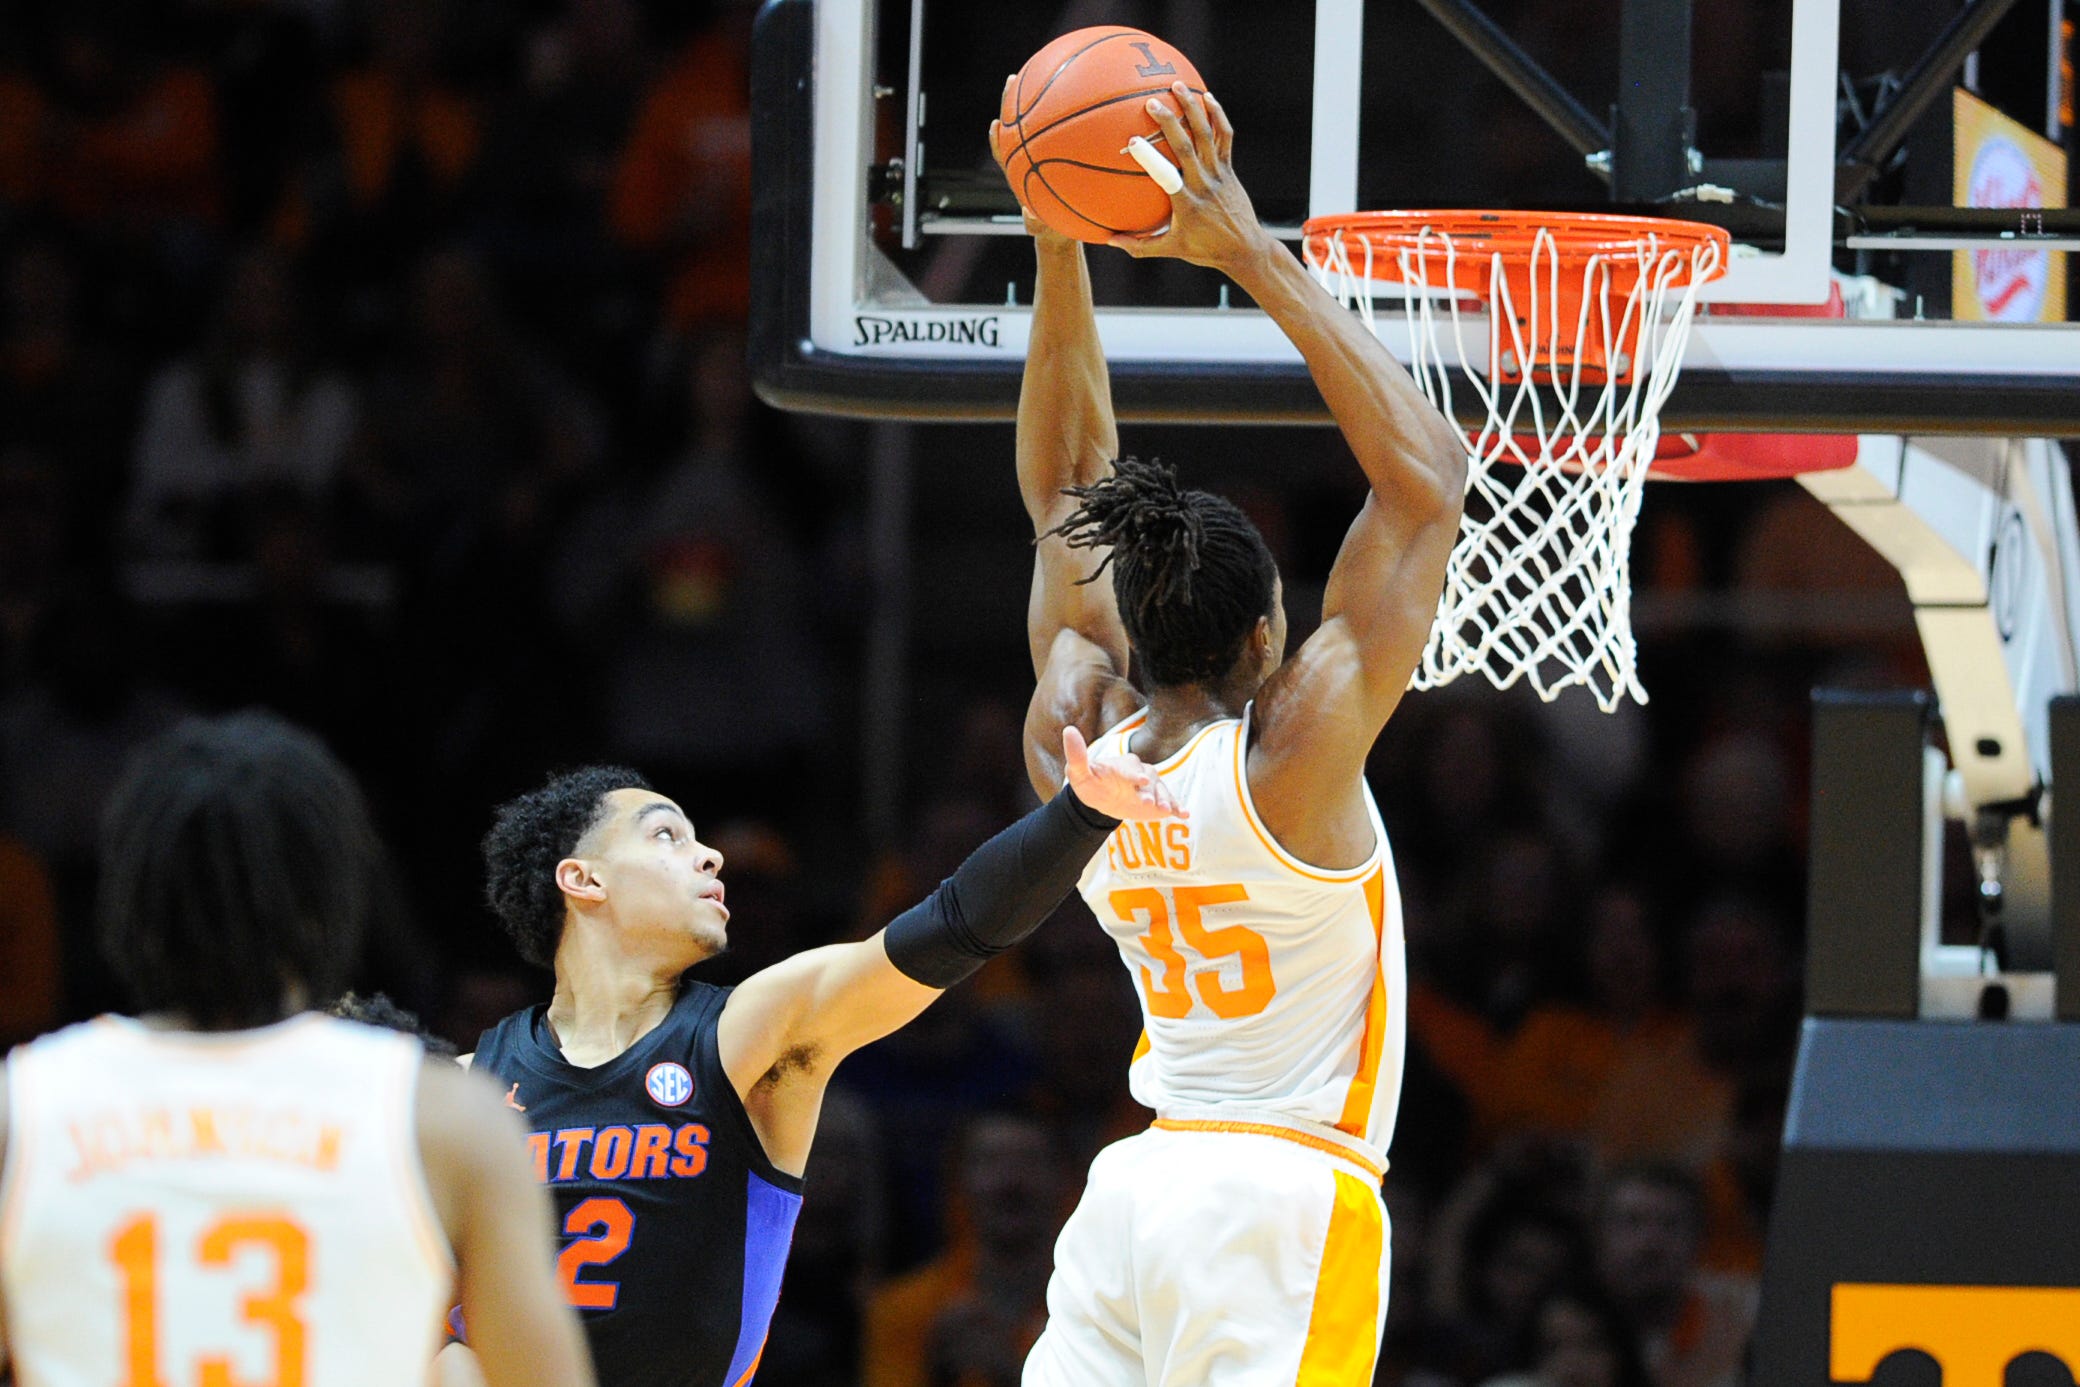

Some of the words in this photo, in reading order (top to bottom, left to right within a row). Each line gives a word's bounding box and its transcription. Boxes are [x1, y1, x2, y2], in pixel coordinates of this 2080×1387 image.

[1128, 42, 1177, 78] T
[854, 316, 998, 348] SPALDING
[1108, 883, 1277, 1020] 35
[651, 1065, 689, 1103] SEC
[526, 1122, 711, 1184] ATORS
[553, 1196, 636, 1311] 2
[105, 1208, 312, 1387] 13
[1828, 1282, 2080, 1387] T
